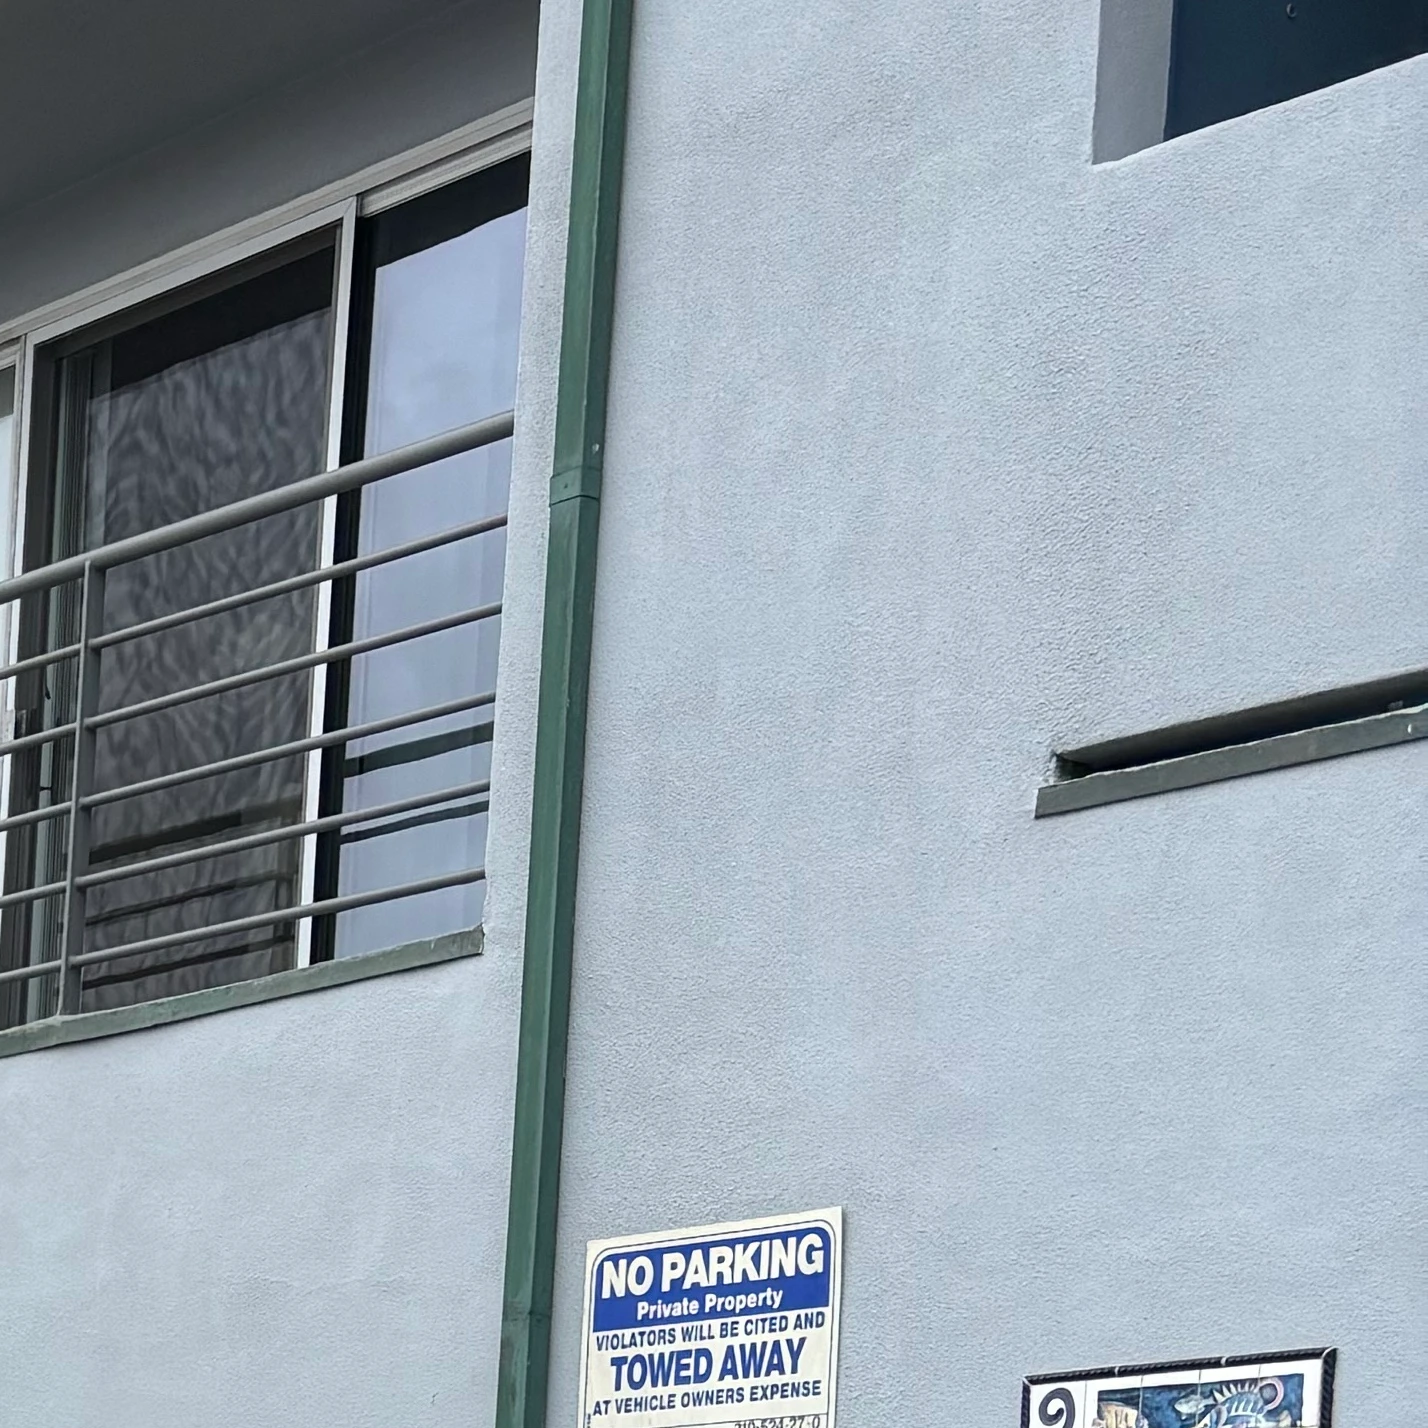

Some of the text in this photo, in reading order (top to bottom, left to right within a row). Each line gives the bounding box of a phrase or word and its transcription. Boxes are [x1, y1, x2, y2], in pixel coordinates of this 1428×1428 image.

[601, 1232, 825, 1299] NO PARKING
[637, 1286, 784, 1321] Private Property
[596, 1311, 826, 1352] VIOLATORS WILL BE CITED AND
[610, 1336, 808, 1392] TOWED AWAY
[592, 1380, 822, 1417] AT VEHICLE OWNERS EXPENSE
